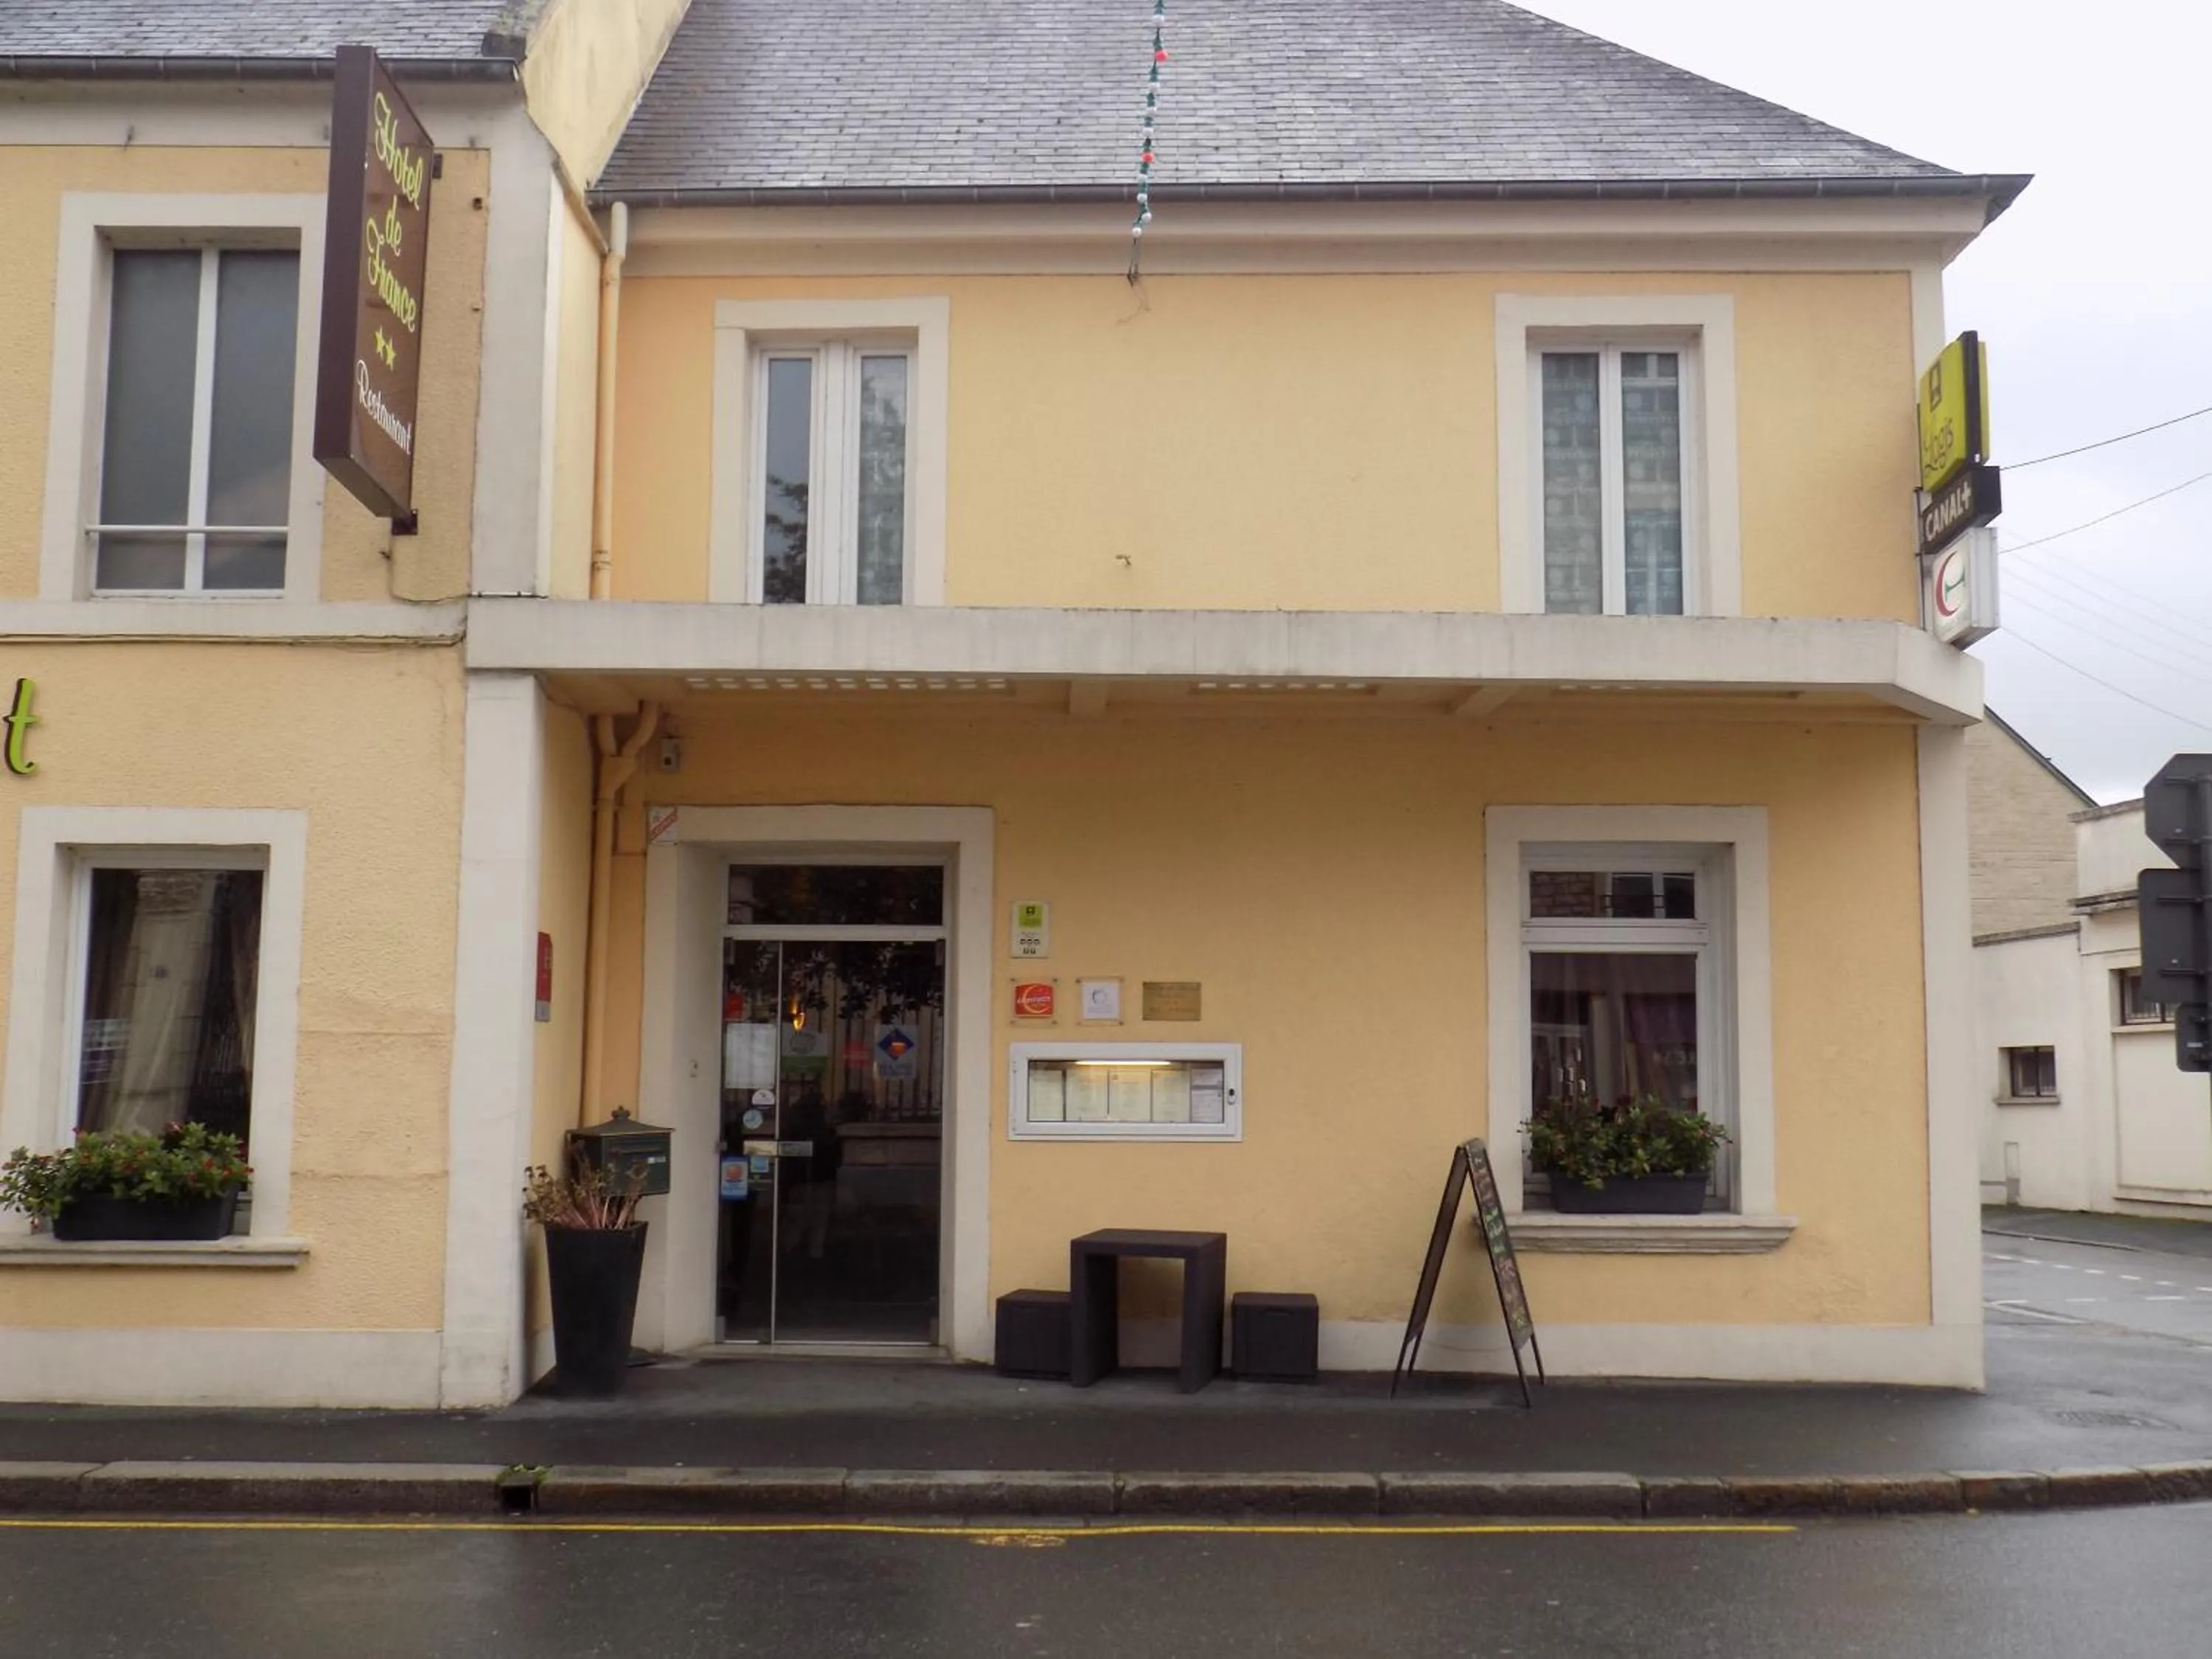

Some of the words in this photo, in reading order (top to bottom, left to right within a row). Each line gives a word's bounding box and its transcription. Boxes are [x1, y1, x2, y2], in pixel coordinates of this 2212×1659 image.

[386, 195, 402, 257] de
[366, 218, 417, 333] France
[356, 359, 412, 456] Restaurant
[1925, 481, 1972, 542] CANAL+
[2, 678, 38, 774] t
